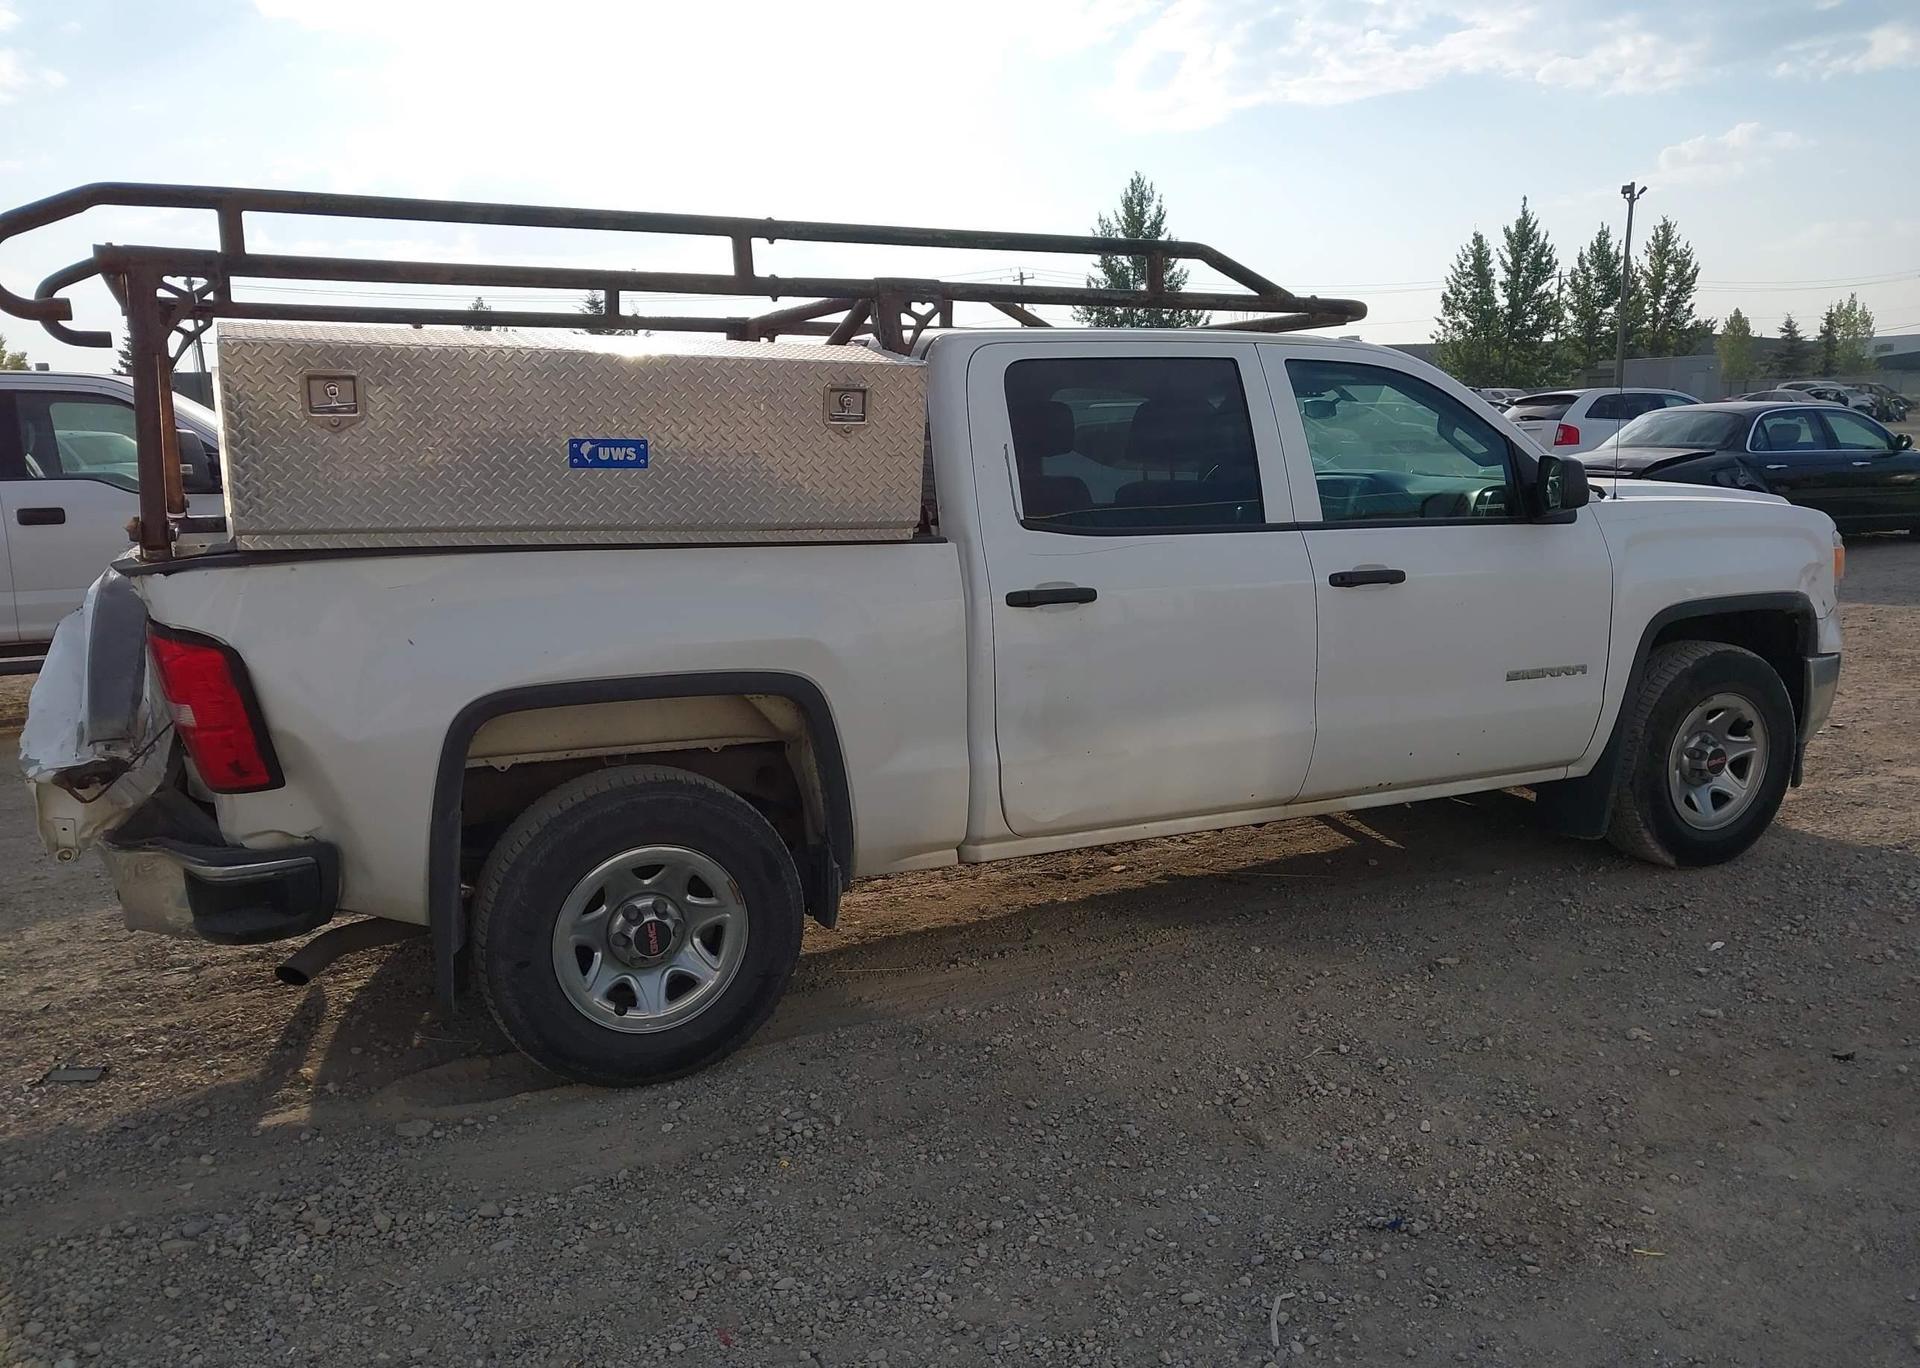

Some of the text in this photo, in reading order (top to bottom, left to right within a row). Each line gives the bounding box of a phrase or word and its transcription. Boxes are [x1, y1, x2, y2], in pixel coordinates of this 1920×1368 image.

[598, 447, 637, 460] UWS
[1506, 664, 1587, 681] SIERRA
[647, 921, 660, 955] GMC
